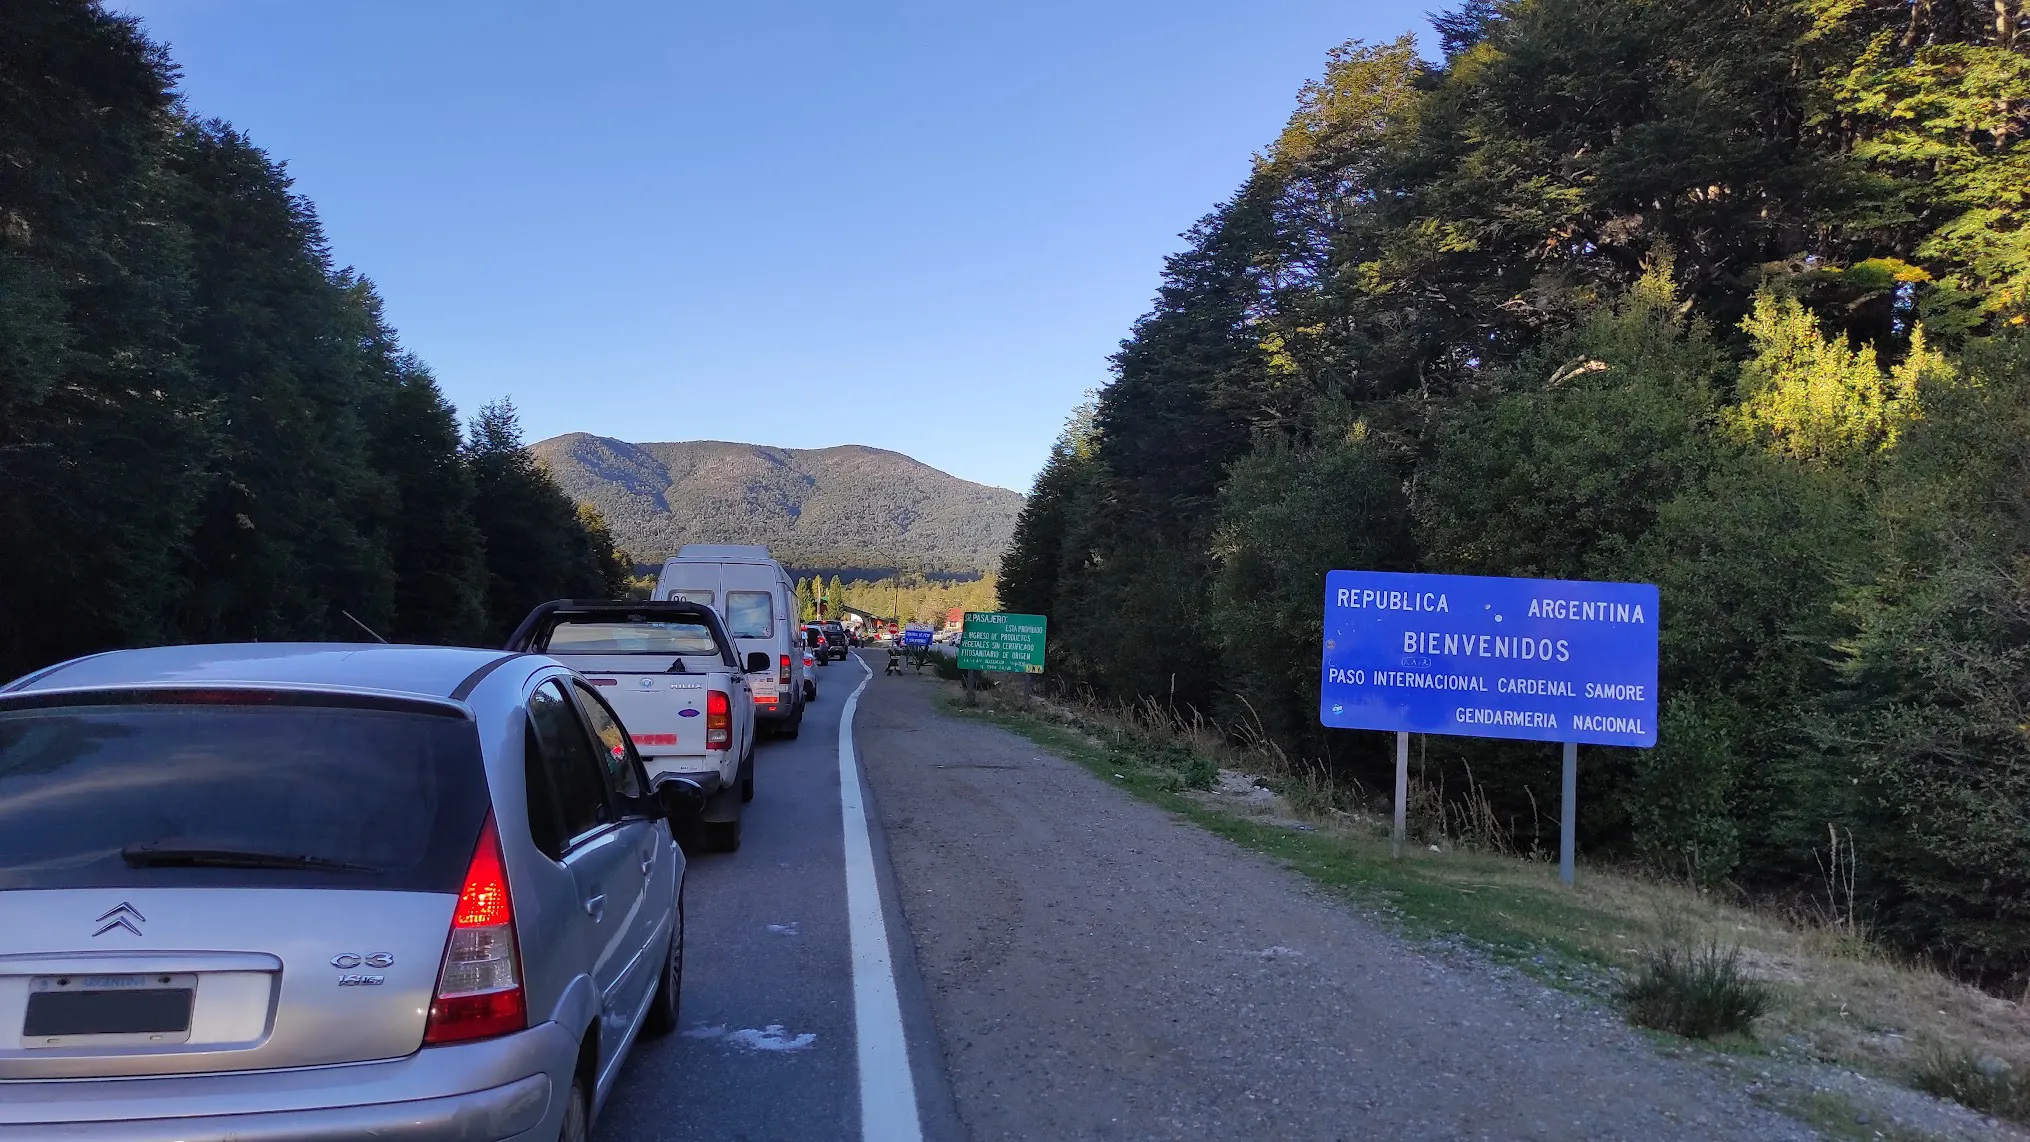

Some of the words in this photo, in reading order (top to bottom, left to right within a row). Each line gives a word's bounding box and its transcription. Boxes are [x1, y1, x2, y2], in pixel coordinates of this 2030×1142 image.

[1337, 588, 1449, 612] REPUBLICA
[1528, 599, 1645, 624] ARGENTINA
[962, 640, 989, 648] VEGETALES
[1002, 642, 1034, 651] CERTIFICADO
[1000, 633, 1030, 642] PRODUCTOS
[961, 650, 999, 658] FITOSANITARIO
[1012, 652, 1030, 660] ORIGEN
[1404, 631, 1570, 662] BIENVENIDOS
[1328, 669, 1365, 685] PASO
[1373, 670, 1488, 692] INTERNACIONAL
[1498, 678, 1576, 697] CARDENAL
[1585, 682, 1645, 701] SAMORE
[1456, 708, 1557, 729] GENDARMERIA
[1573, 715, 1646, 734] NACIONAL
[330, 952, 395, 969] C3
[82, 974, 147, 988] ARGENTINA
